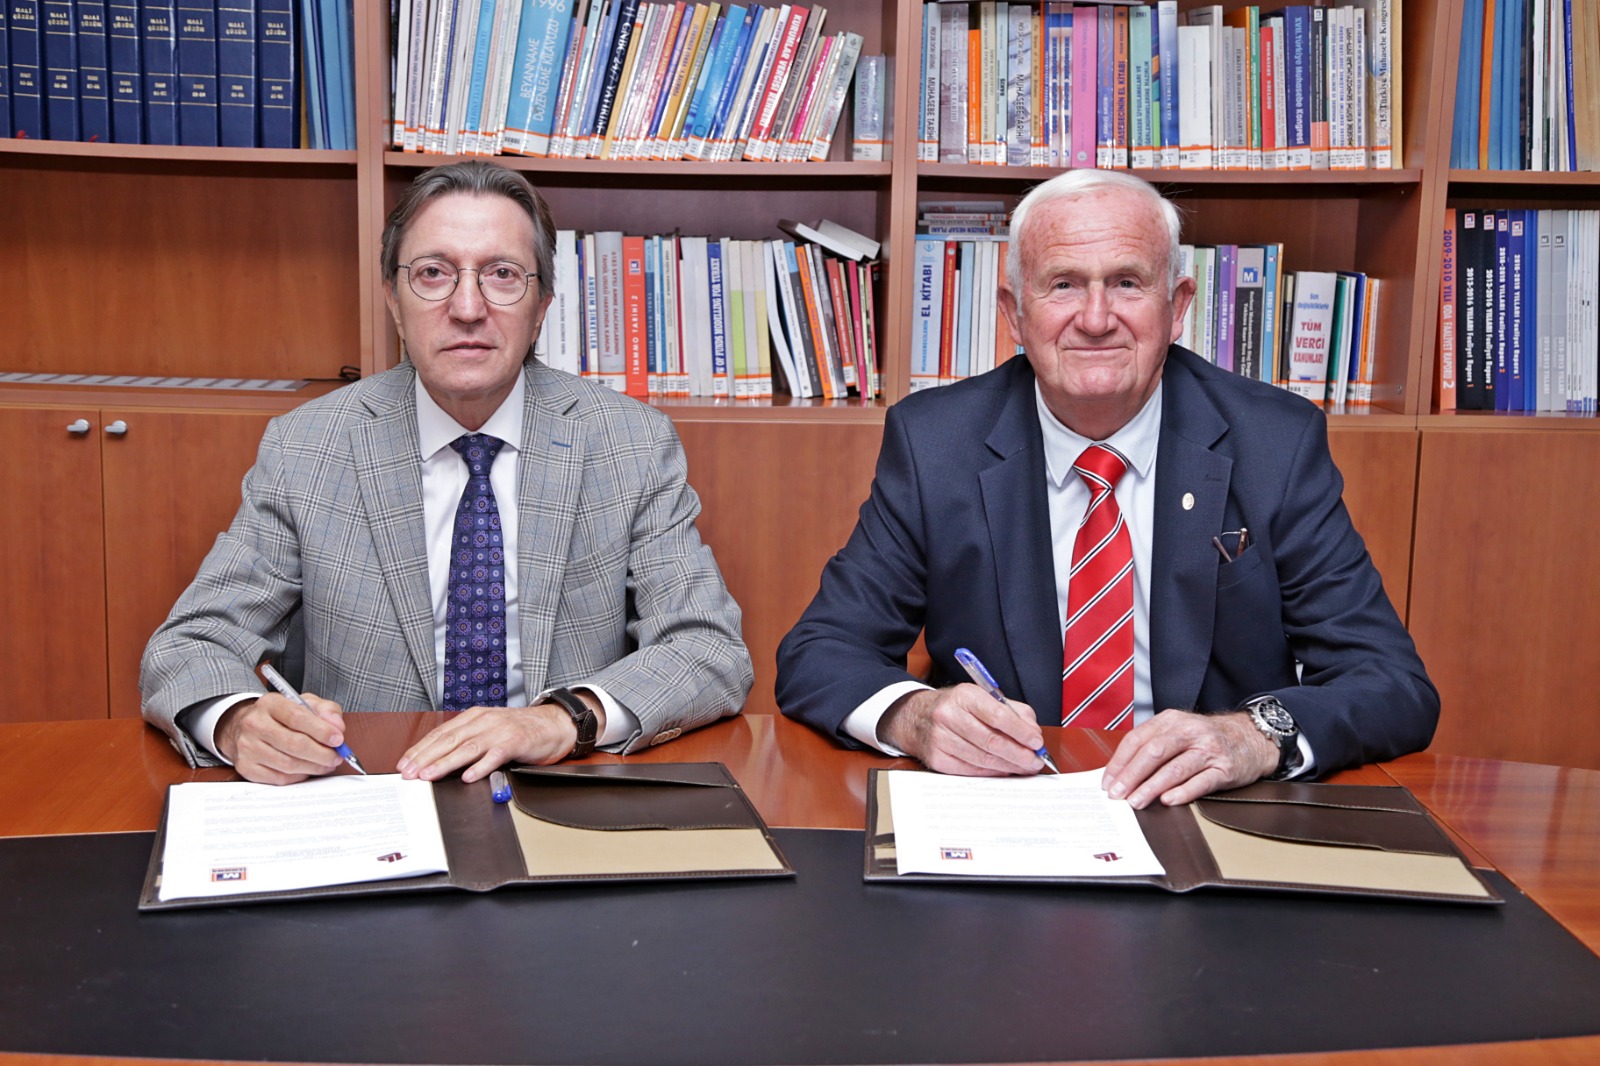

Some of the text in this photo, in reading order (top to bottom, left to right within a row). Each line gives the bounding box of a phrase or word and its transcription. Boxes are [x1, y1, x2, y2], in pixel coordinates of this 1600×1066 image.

[781, 14, 803, 59] KURUMLAR
[520, 38, 540, 98] BEYANNAME
[533, 18, 559, 121] DÜZENLEME KILAVUZU
[1379, 36, 1387, 76] Muhasebe
[771, 60, 789, 91] VERGİSİ
[1117, 61, 1125, 85] KİTABI
[1295, 66, 1304, 107] Muhasebe
[926, 77, 936, 116] MUHASEBE
[1379, 78, 1387, 110] Türkiye
[758, 92, 778, 128] REHBERİ
[1296, 108, 1305, 144] Kongresi
[710, 257, 720, 283] TURKEY
[920, 264, 932, 301] KİTABI
[711, 284, 720, 297] FOR
[588, 276, 597, 349] ANONİM ŞİRKETLER
[630, 304, 639, 333] TARİHİ
[712, 298, 723, 334] MODELLING
[921, 305, 931, 317] EL
[1443, 229, 1454, 389] 2009-2010 YILI ODA FAALİYET RAPORU 2
[1301, 319, 1322, 332] TÜM
[1497, 312, 1506, 341] Faaliyet
[1512, 319, 1521, 348] Faaliyet
[631, 336, 640, 374] İSMMMO
[713, 336, 723, 356] FUNDS
[1295, 334, 1325, 349] VERGİ
[1466, 332, 1474, 358] Faaliyet
[714, 357, 723, 366] OF
[1294, 353, 1323, 364] KANUNLARI
[1484, 361, 1492, 383] Raporu
